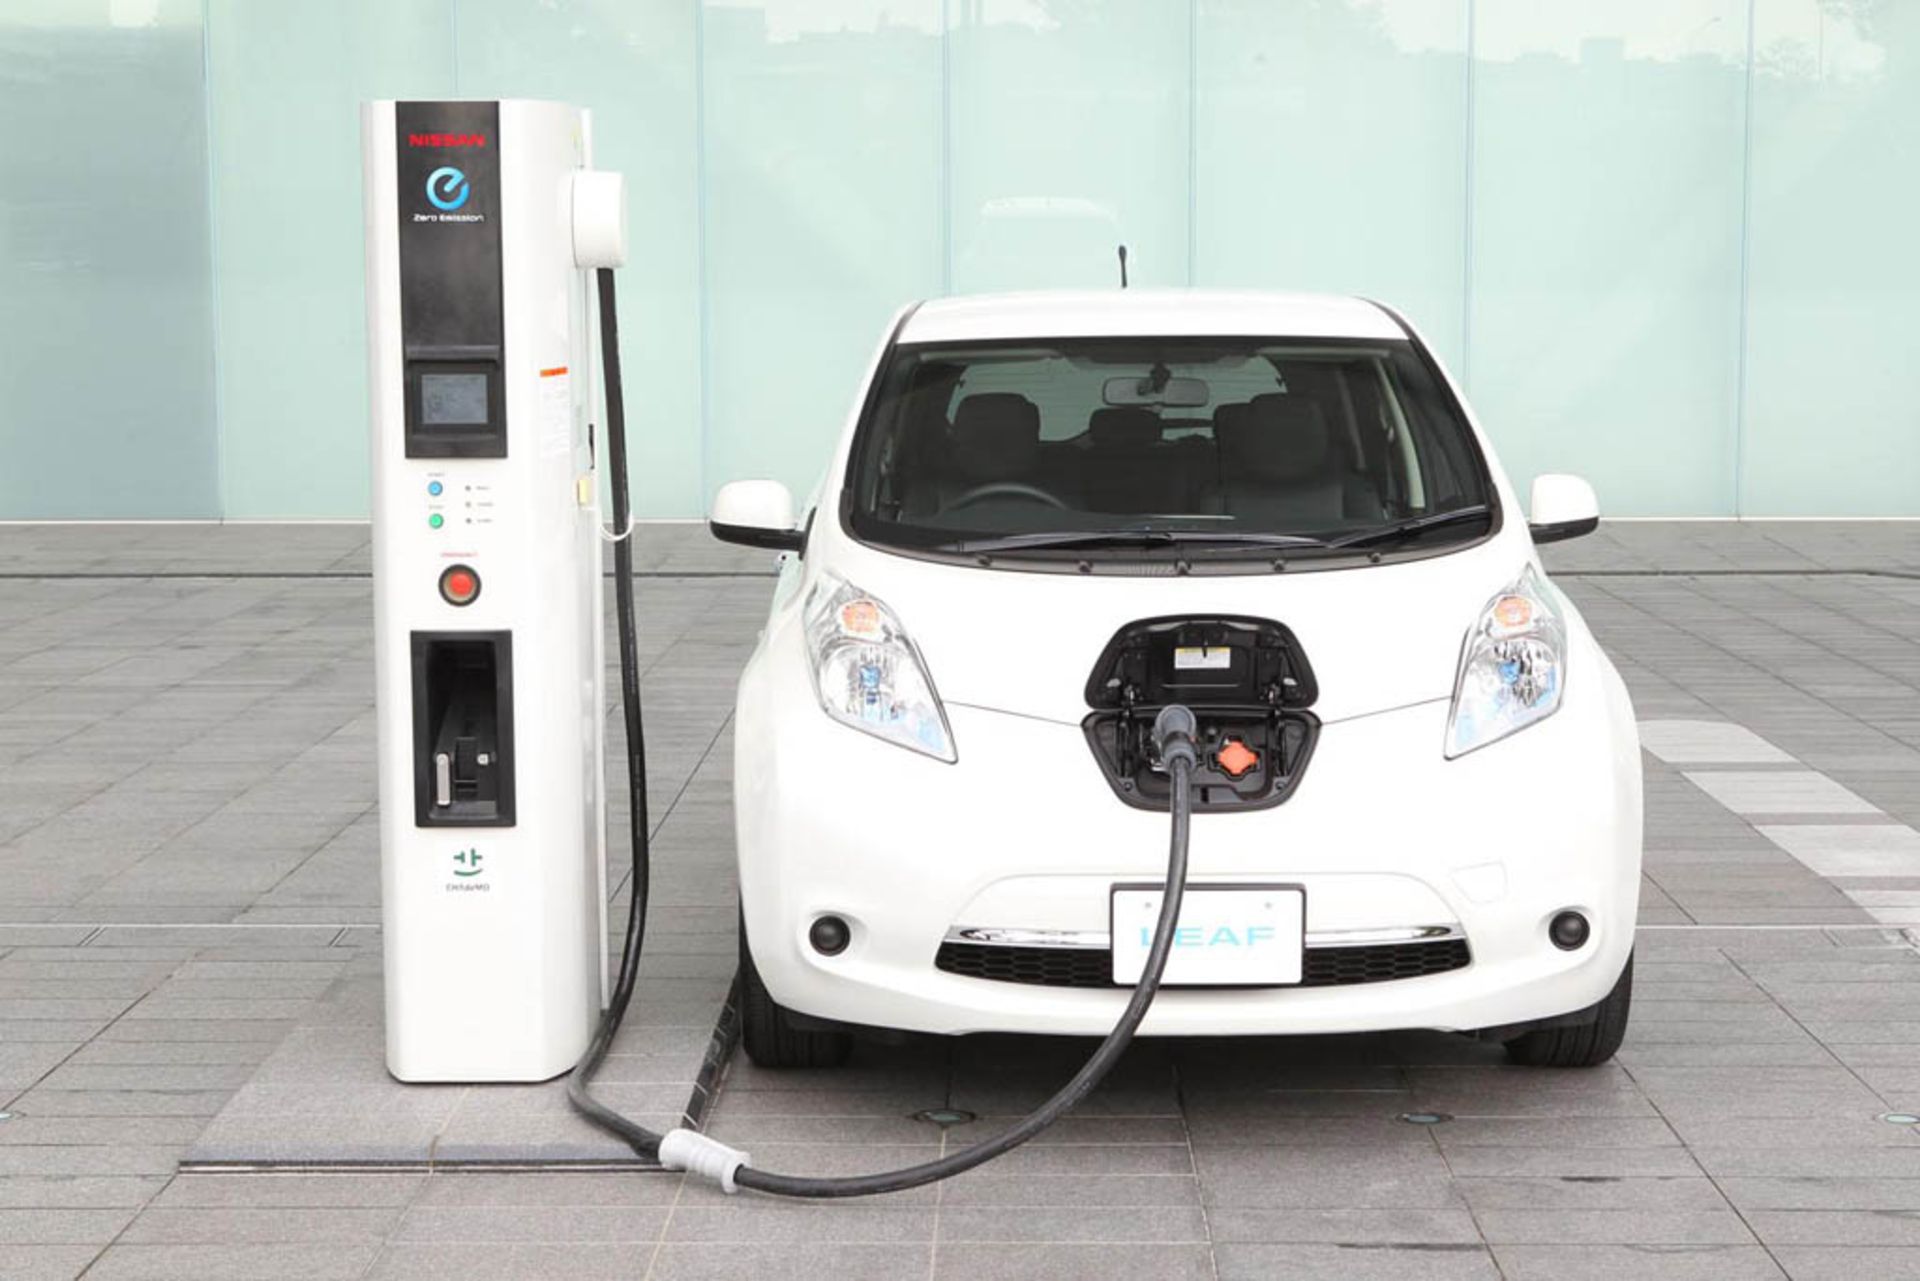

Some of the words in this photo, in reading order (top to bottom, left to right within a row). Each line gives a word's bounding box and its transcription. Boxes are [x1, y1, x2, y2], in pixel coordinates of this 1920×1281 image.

[409, 133, 485, 147] NISSAN
[413, 213, 437, 222] Zero
[439, 213, 484, 222] Emission
